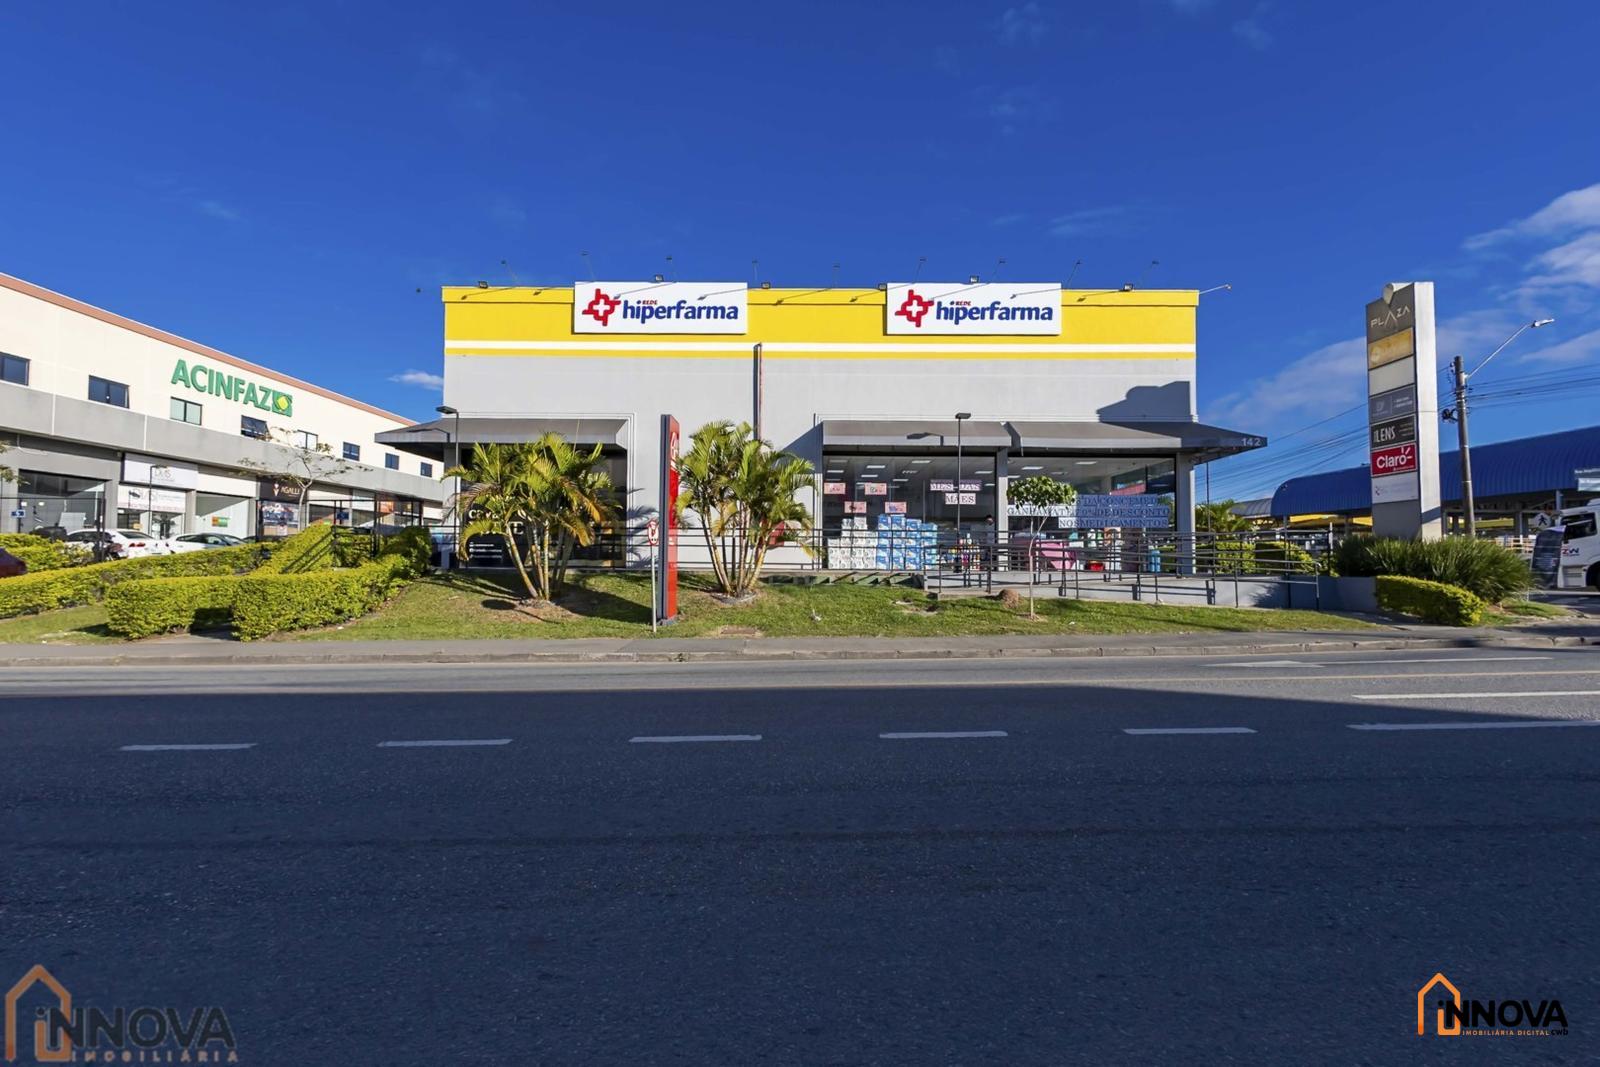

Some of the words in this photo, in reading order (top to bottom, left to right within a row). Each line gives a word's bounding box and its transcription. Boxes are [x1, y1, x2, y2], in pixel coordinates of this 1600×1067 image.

[622, 300, 739, 324] hiperfarma
[936, 301, 1053, 325] hiperfarma
[1370, 305, 1411, 329] PLAZA
[171, 358, 273, 411] ACINFAZ
[1241, 437, 1261, 447] 142
[1376, 426, 1396, 443] LENS
[1376, 454, 1407, 469] Claro
